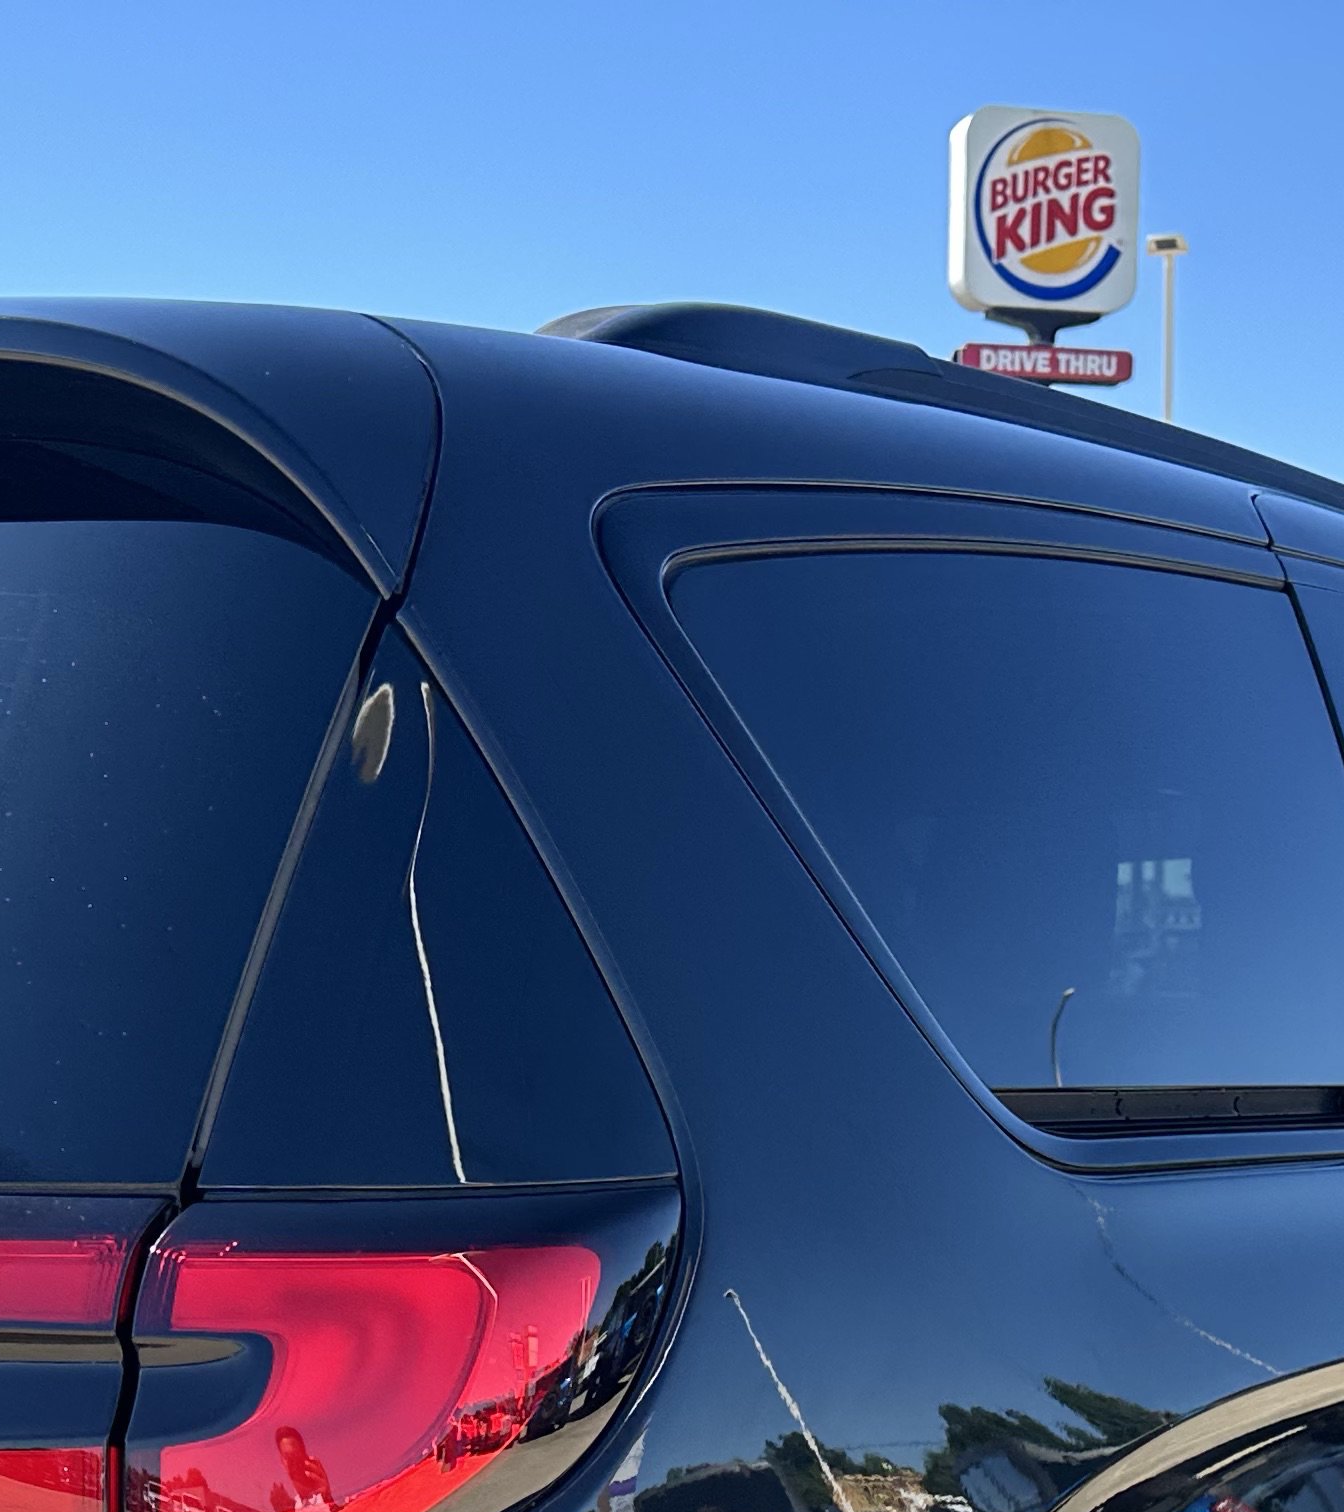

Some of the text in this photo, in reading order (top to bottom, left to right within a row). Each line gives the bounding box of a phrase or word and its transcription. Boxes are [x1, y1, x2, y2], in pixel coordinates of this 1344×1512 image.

[990, 155, 1112, 212] BURGER
[994, 187, 1116, 261] KING
[979, 349, 1117, 376] DRIVE THRU
